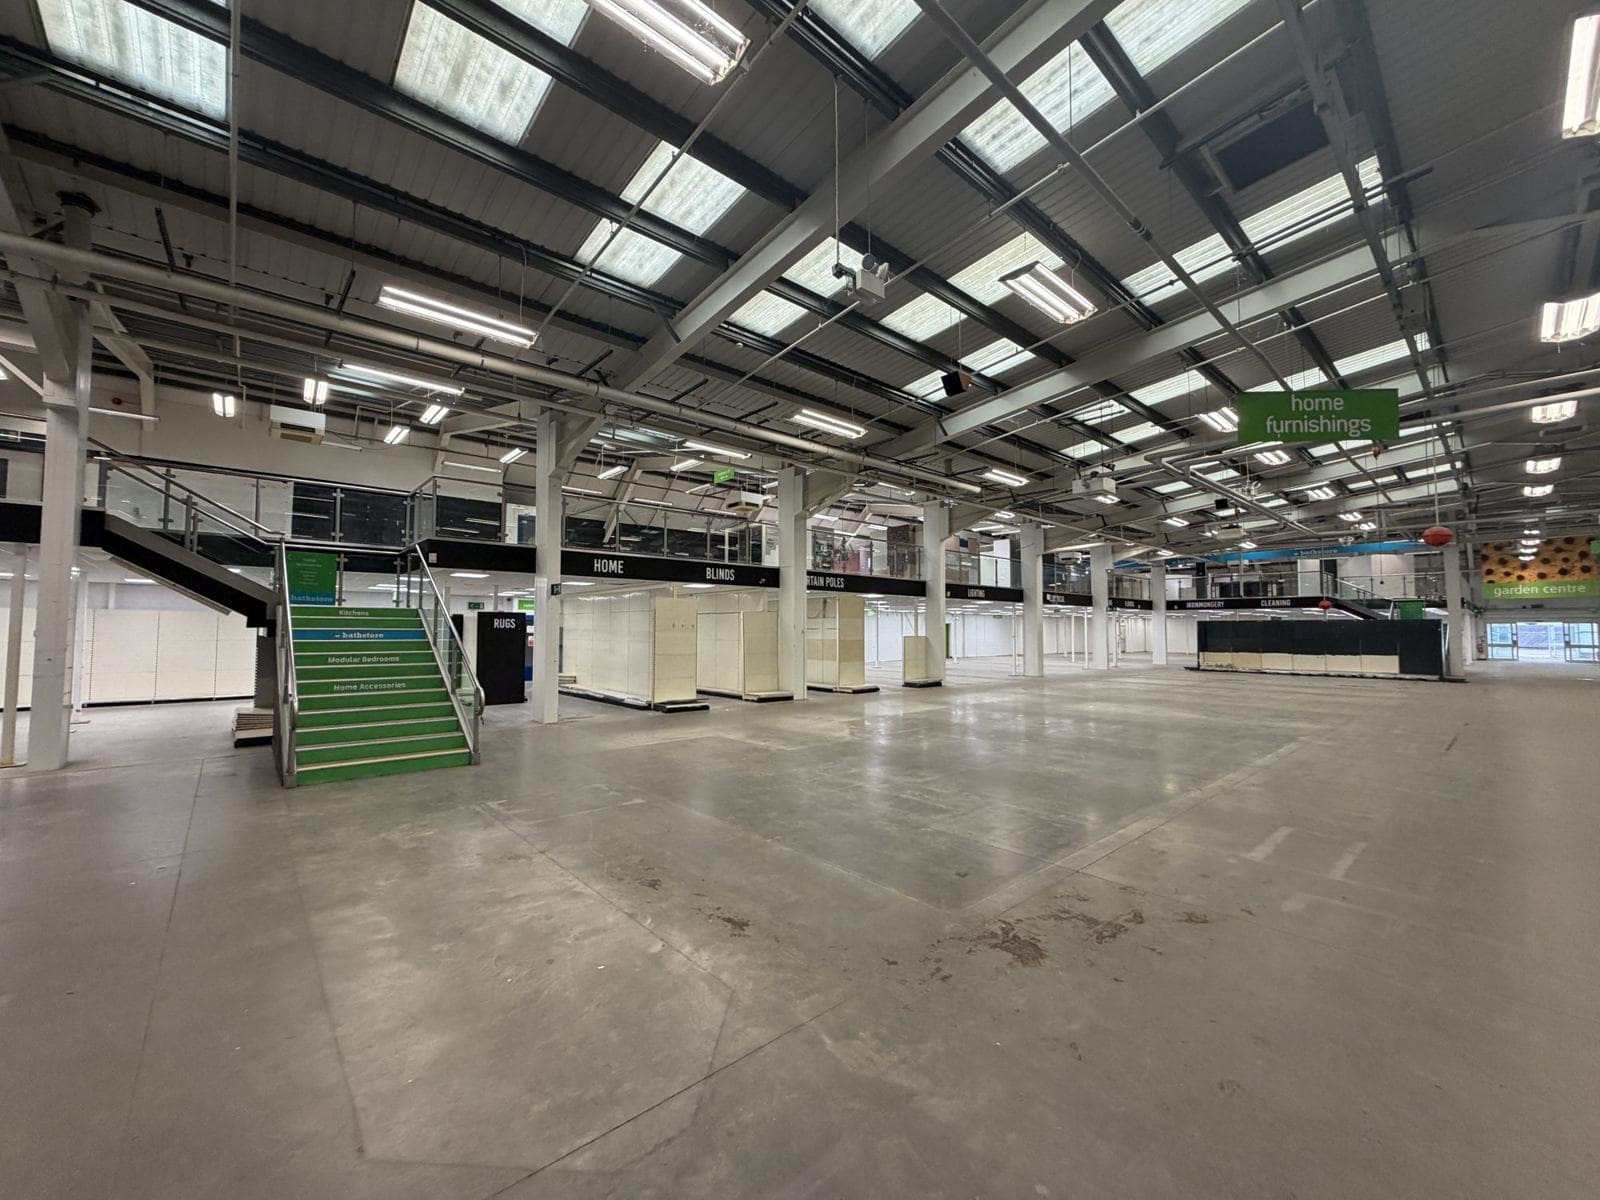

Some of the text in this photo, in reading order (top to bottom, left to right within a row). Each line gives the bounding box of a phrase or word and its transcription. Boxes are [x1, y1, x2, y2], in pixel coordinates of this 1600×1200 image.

[1291, 394, 1344, 412] home
[1266, 414, 1371, 437] furnishings
[593, 558, 625, 574] HOME
[705, 567, 735, 581] BLINDS
[807, 575, 845, 588] RTAIN POLES
[1493, 584, 1587, 597] garden centre
[1260, 599, 1291, 607] CLEANING
[338, 609, 370, 617] Kitchens
[493, 618, 516, 629] RUGS
[342, 631, 384, 639] bathstore
[327, 655, 400, 664] Modular Bedrooms
[333, 681, 407, 692] Home Accessories
